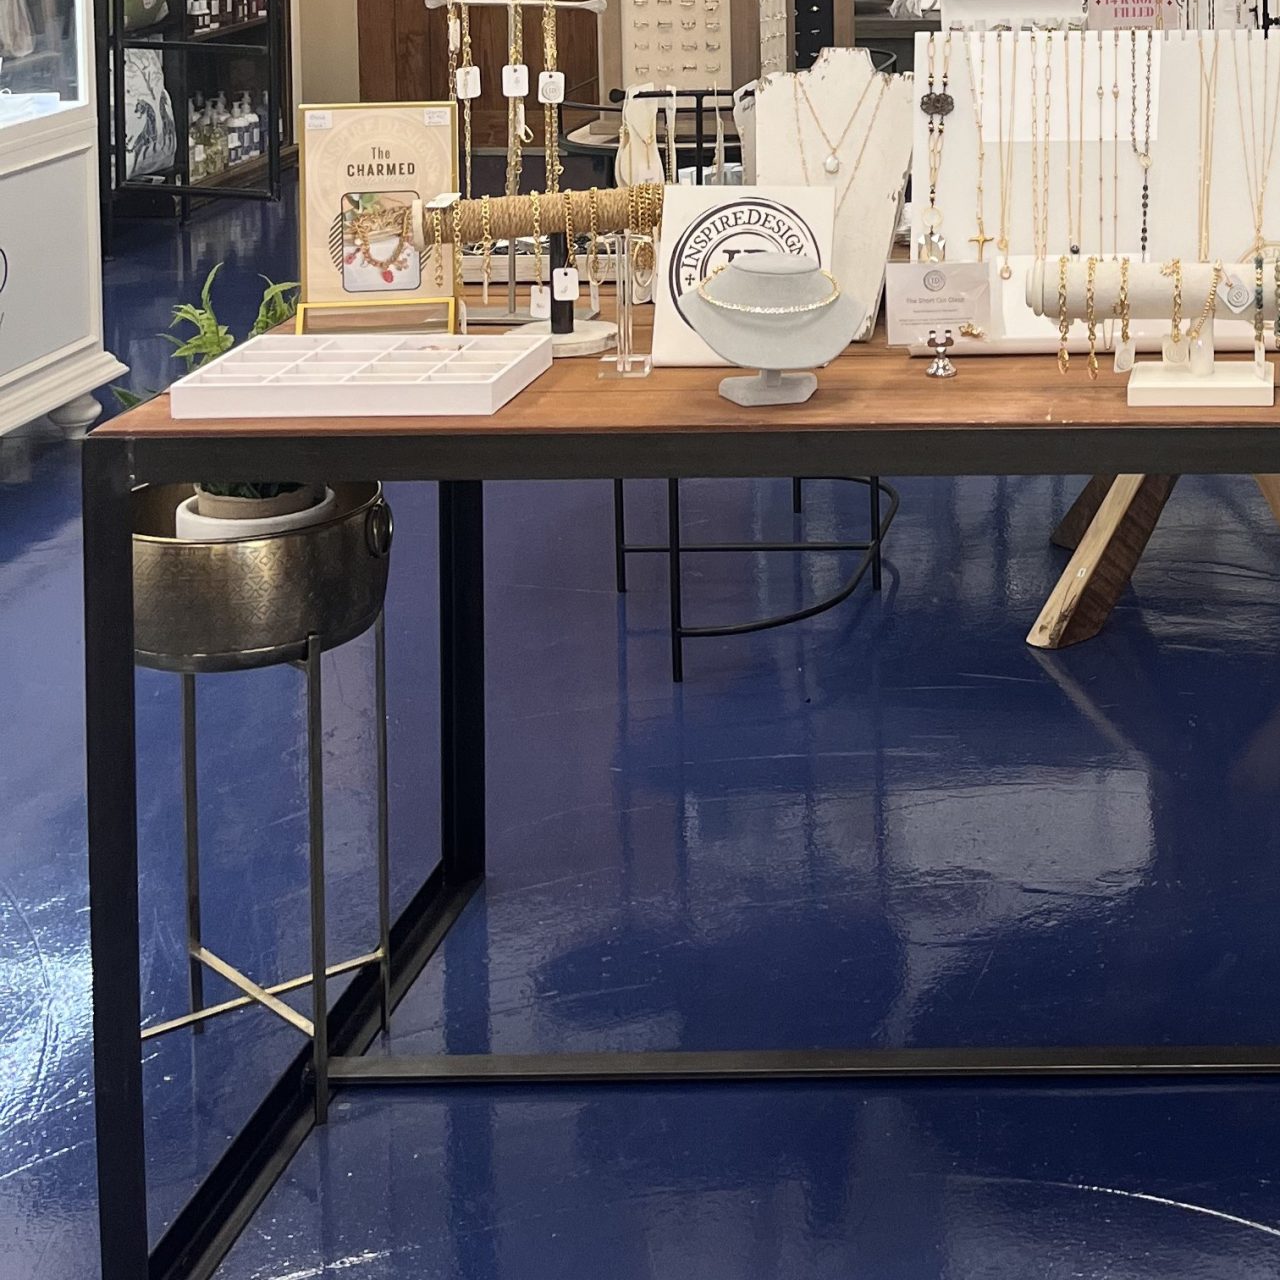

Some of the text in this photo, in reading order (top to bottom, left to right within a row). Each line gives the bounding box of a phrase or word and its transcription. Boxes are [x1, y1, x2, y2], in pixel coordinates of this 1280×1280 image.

[1114, 6, 1155, 18] FILLED
[371, 147, 391, 160] The
[346, 162, 415, 177] CHARMED
[680, 208, 808, 271] INSPIREDESIGN
